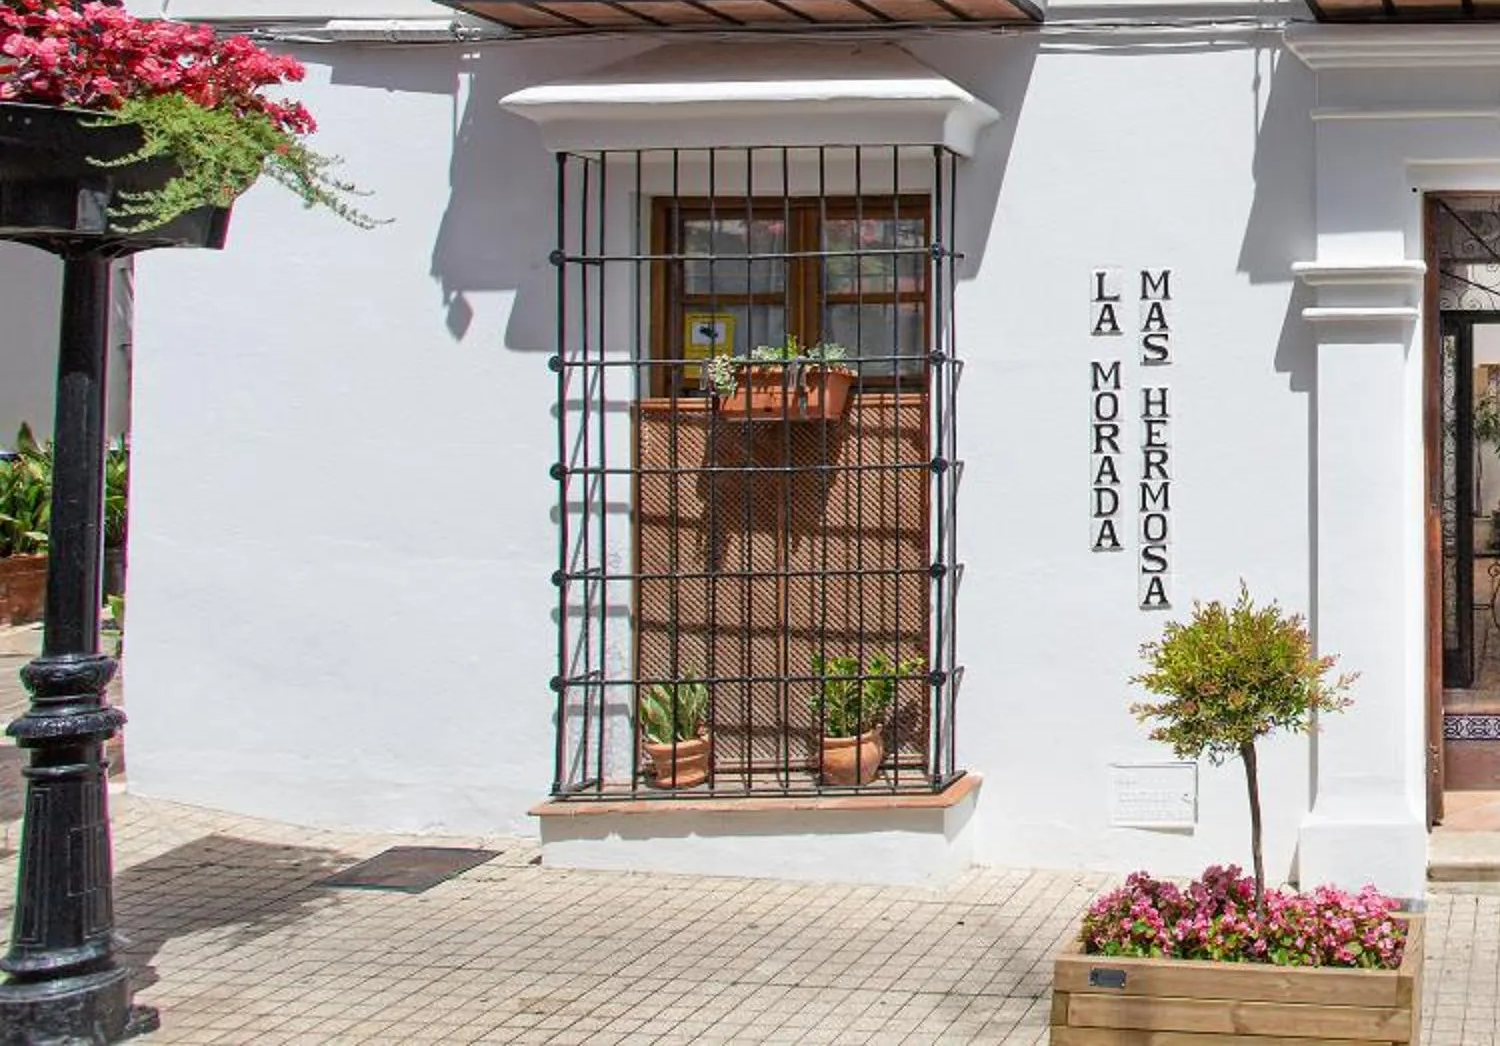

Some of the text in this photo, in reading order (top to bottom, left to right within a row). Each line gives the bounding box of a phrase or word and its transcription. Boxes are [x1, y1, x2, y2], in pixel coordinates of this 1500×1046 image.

[1091, 271, 1121, 548] LA MORADA
[1140, 270, 1171, 605] MAS HERMOSA
